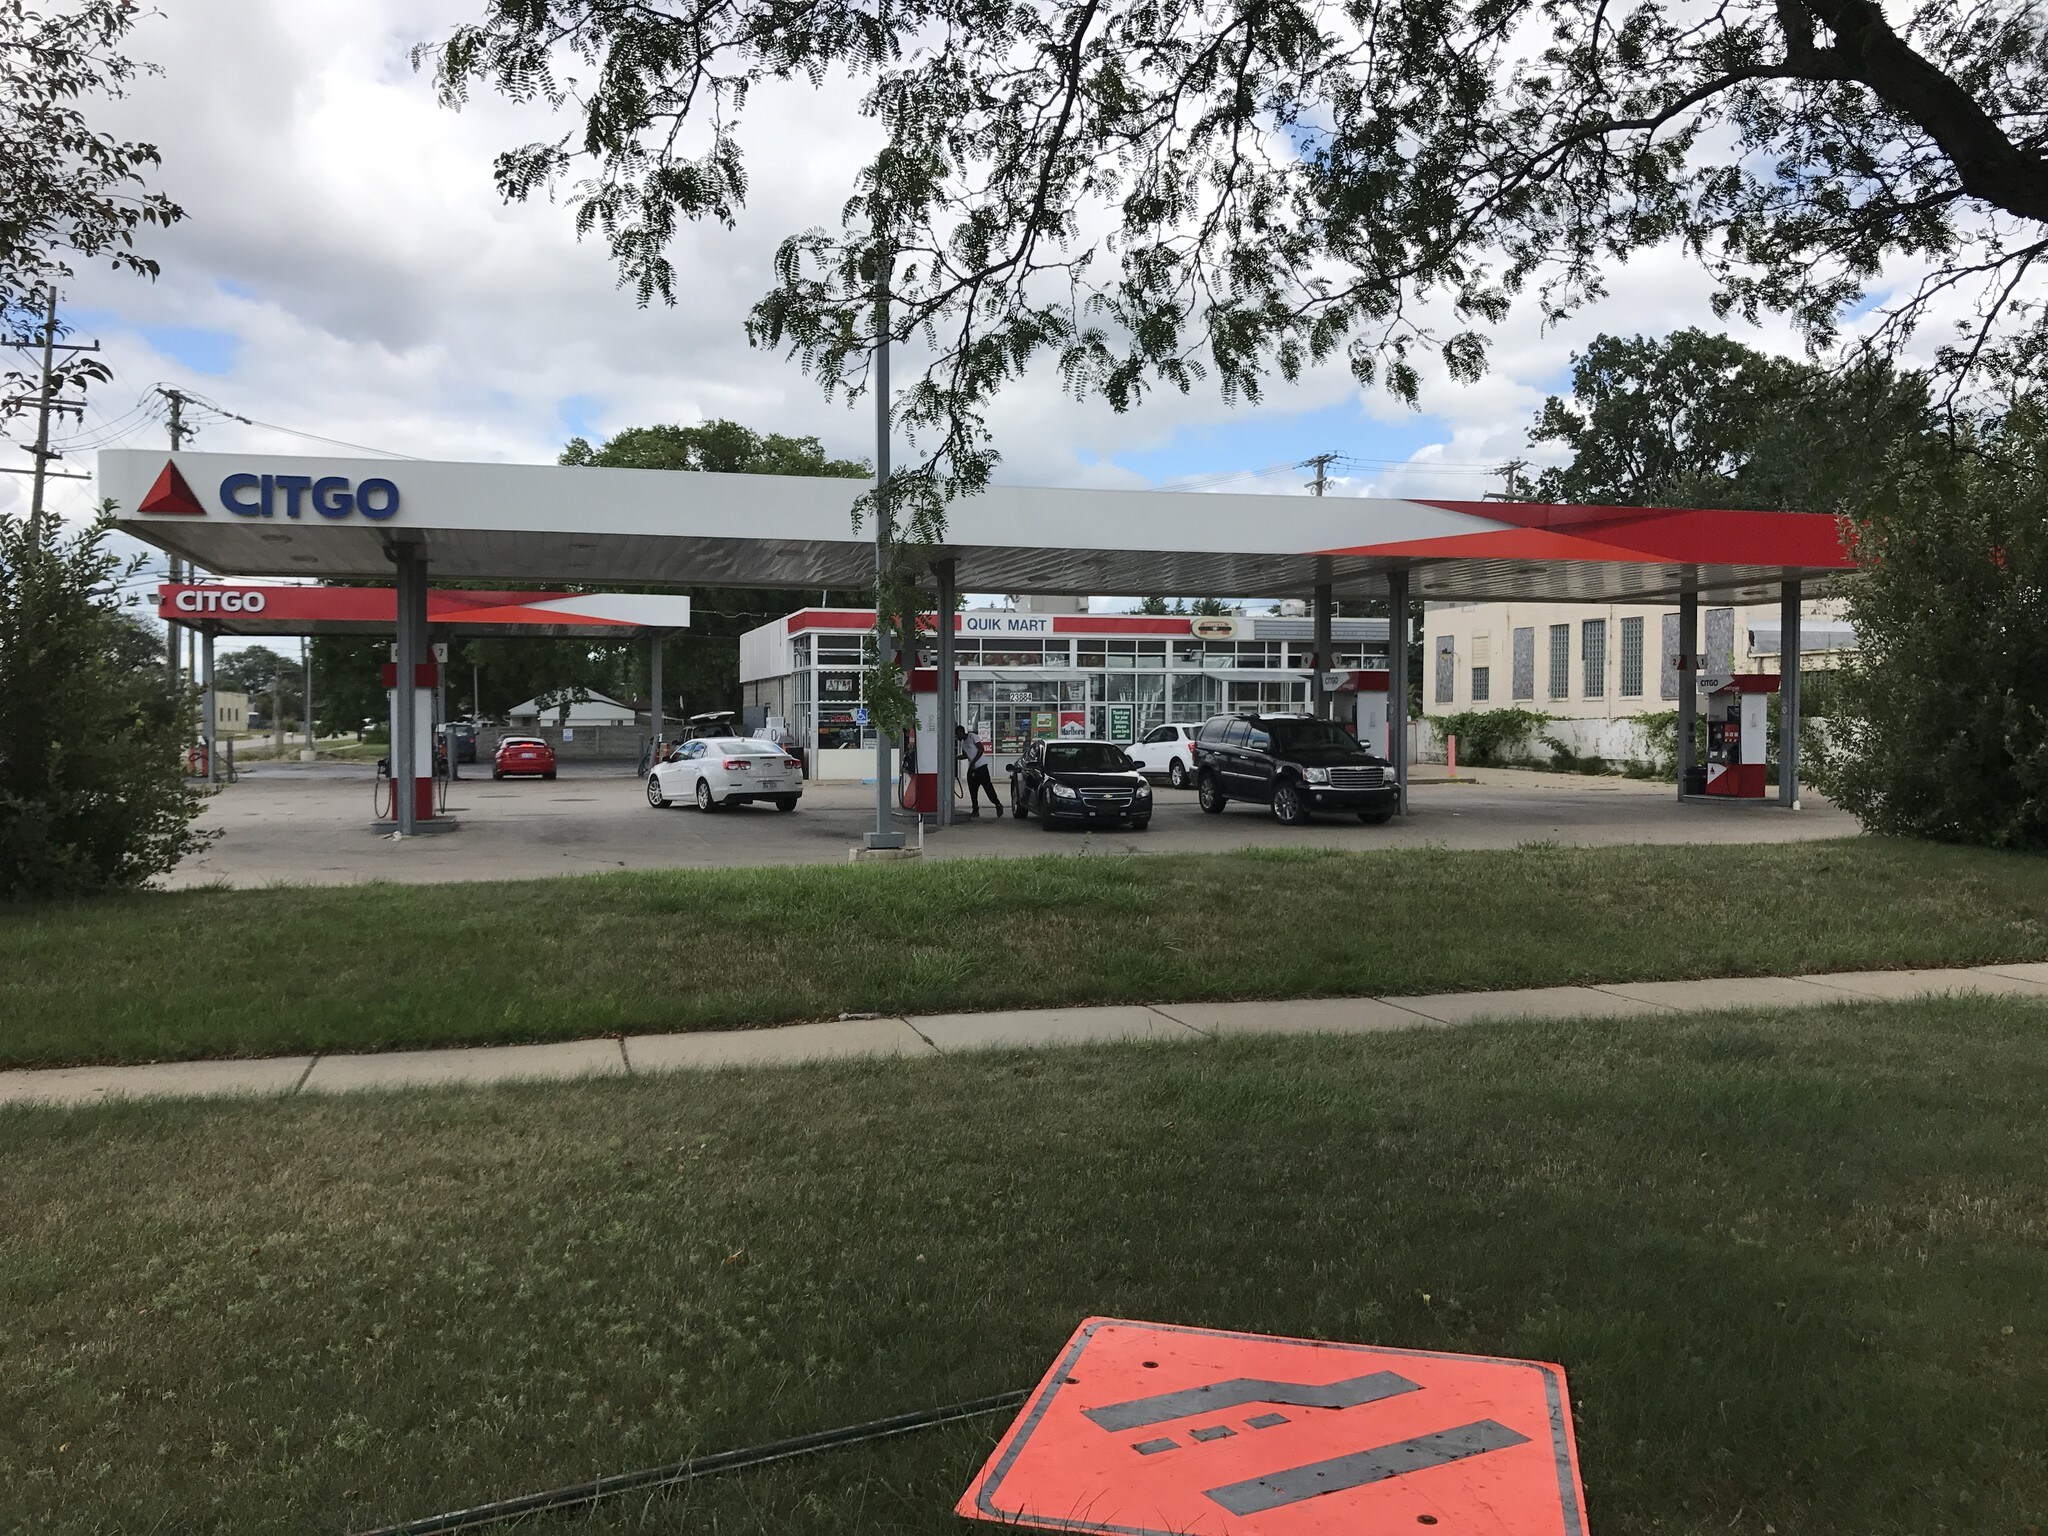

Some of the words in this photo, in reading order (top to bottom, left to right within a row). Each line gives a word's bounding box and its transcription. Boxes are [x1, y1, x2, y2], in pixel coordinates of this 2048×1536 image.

[220, 473, 400, 520] CITGO
[176, 590, 265, 612] CITGO
[967, 617, 1001, 631] QUIK
[1007, 619, 1047, 631] MART
[438, 648, 444, 657] 7
[923, 654, 928, 663] 5
[1700, 679, 1718, 687] CITGO
[1061, 726, 1085, 735] Marlboro
